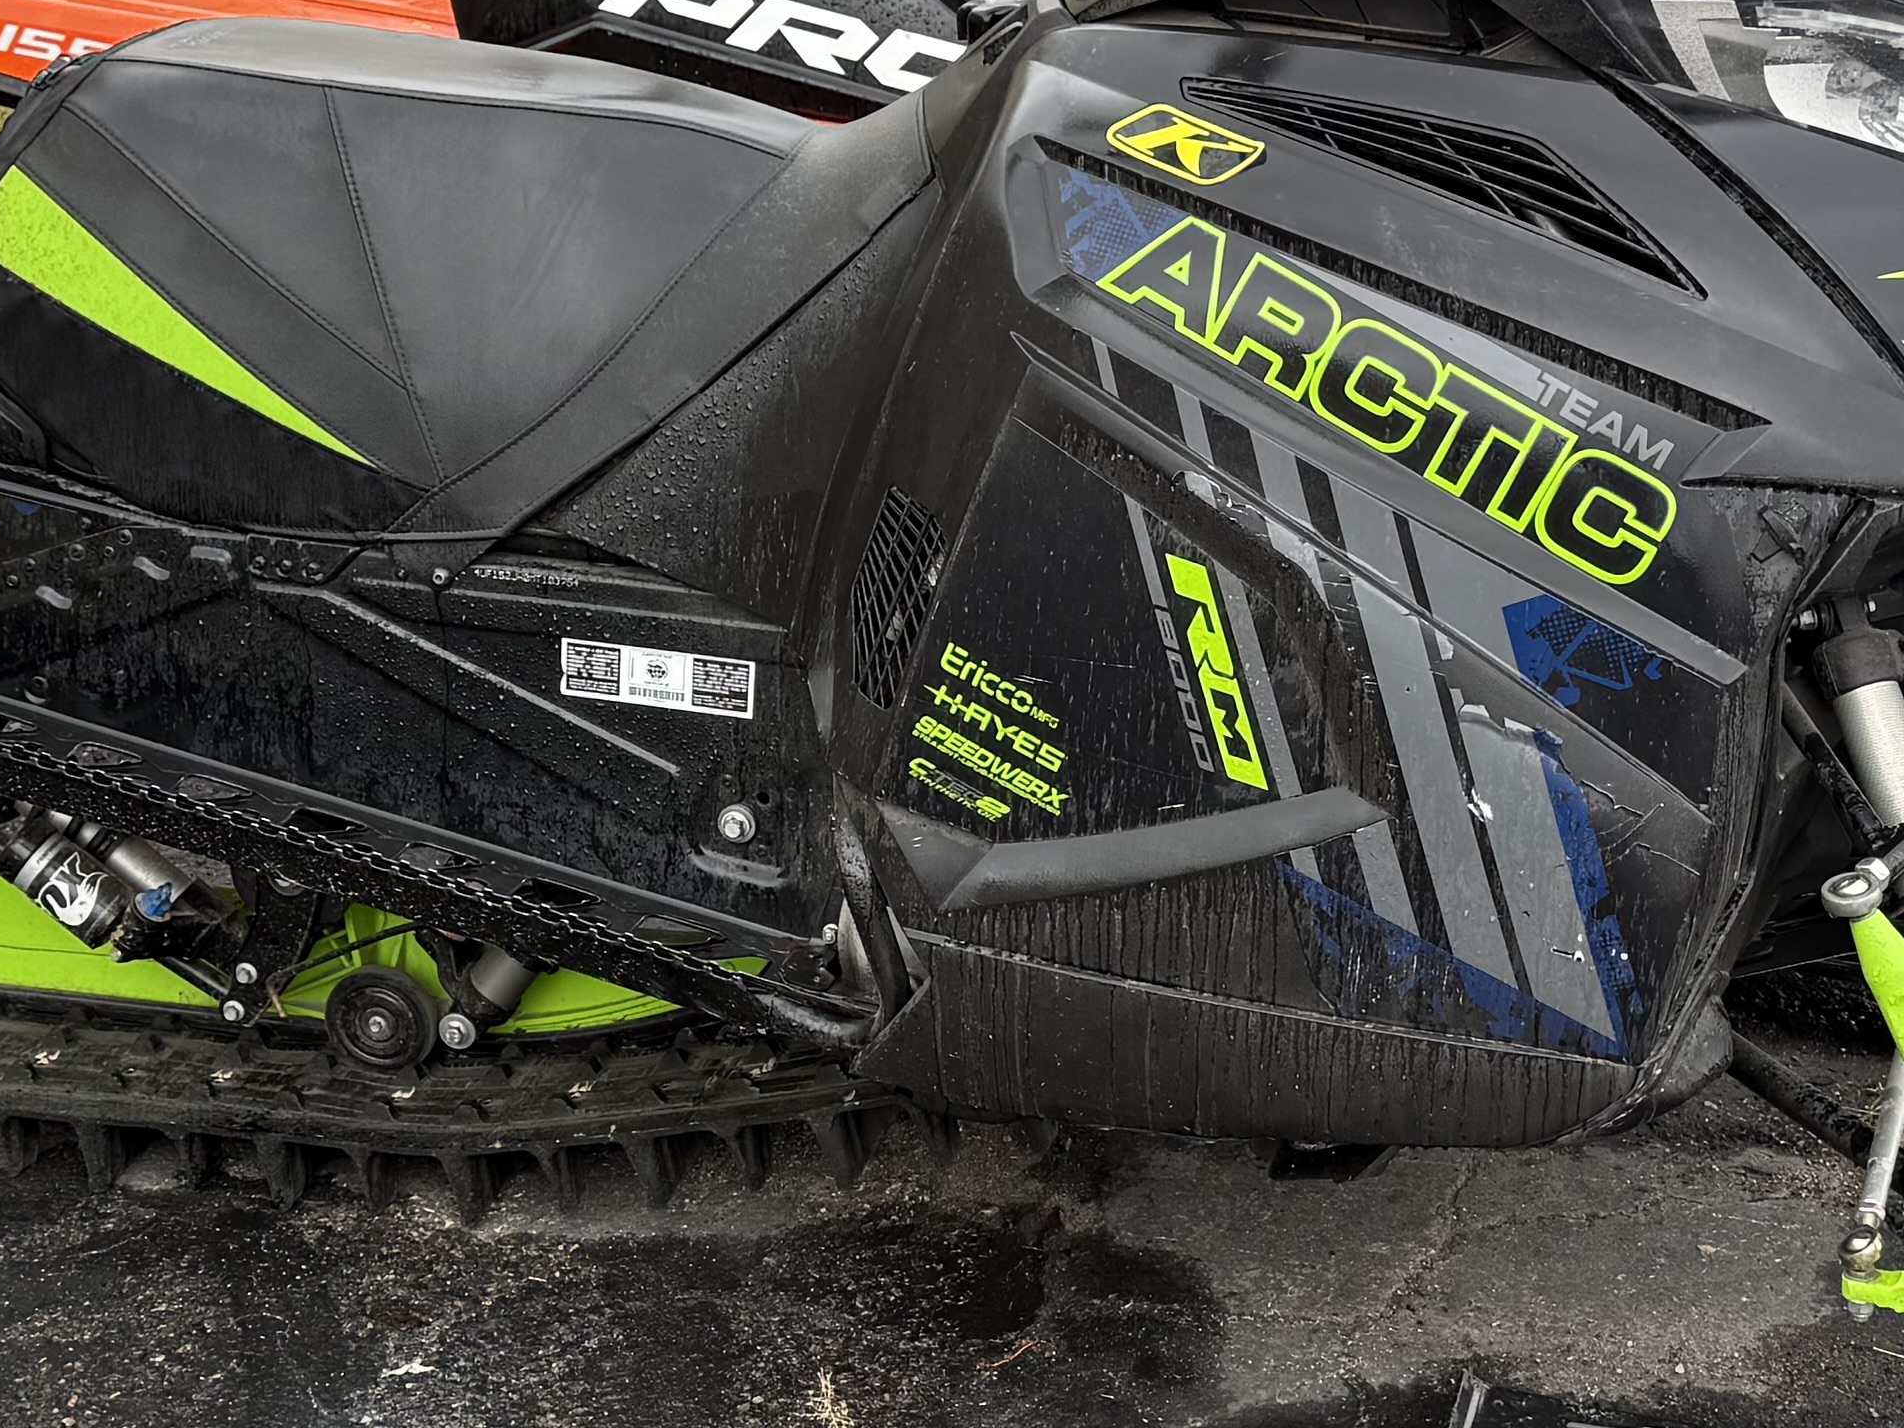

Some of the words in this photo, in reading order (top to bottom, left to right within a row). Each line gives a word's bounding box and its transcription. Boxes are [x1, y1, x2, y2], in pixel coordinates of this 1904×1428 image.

[1097, 216, 1676, 585] ARCTIC
[1529, 369, 1676, 471] TEAM
[923, 683, 1067, 772] HAYES
[940, 641, 1033, 714] Ericco
[1029, 705, 1060, 729] MFG
[1154, 607, 1215, 772] 8000
[914, 715, 1072, 809] SPEEDWERX
